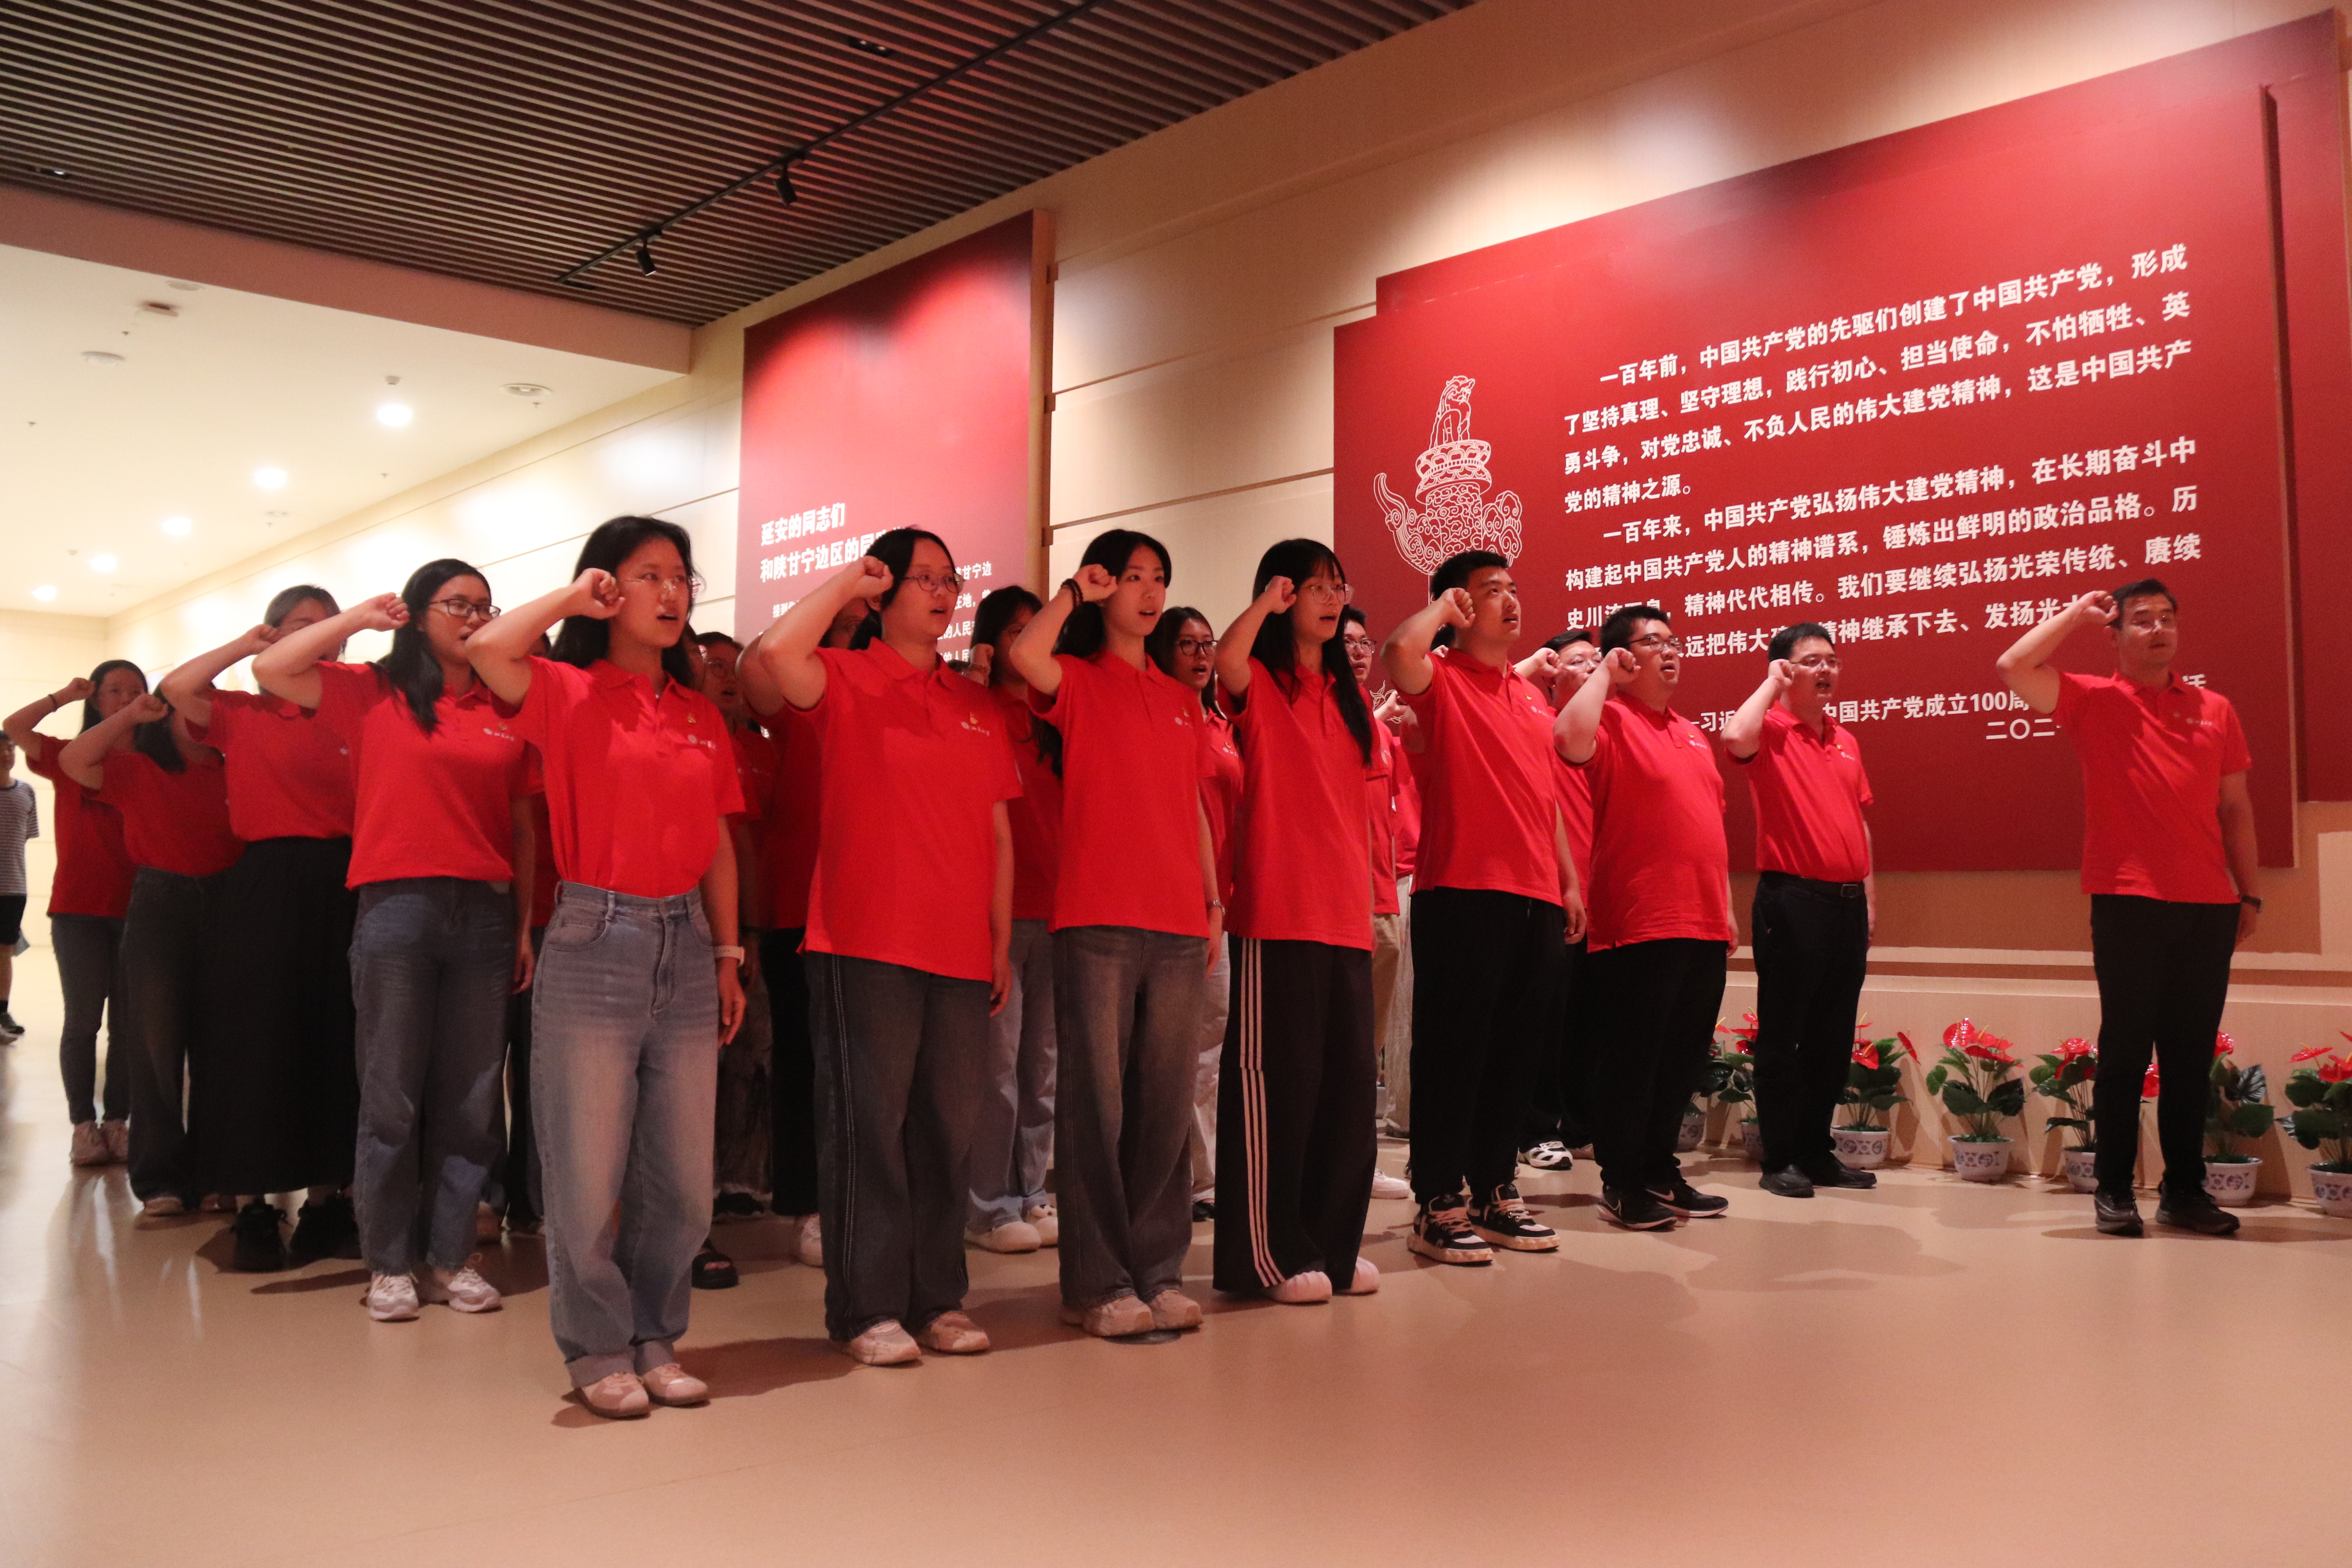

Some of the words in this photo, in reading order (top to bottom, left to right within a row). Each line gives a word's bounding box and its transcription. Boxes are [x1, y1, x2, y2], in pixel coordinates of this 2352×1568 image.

[1564, 474, 1691, 513] 党的精神之源。
[760, 503, 846, 546] 延安的同志们
[760, 526, 906, 583] 和陕甘宁边区的同
[937, 621, 975, 640] 的人民
